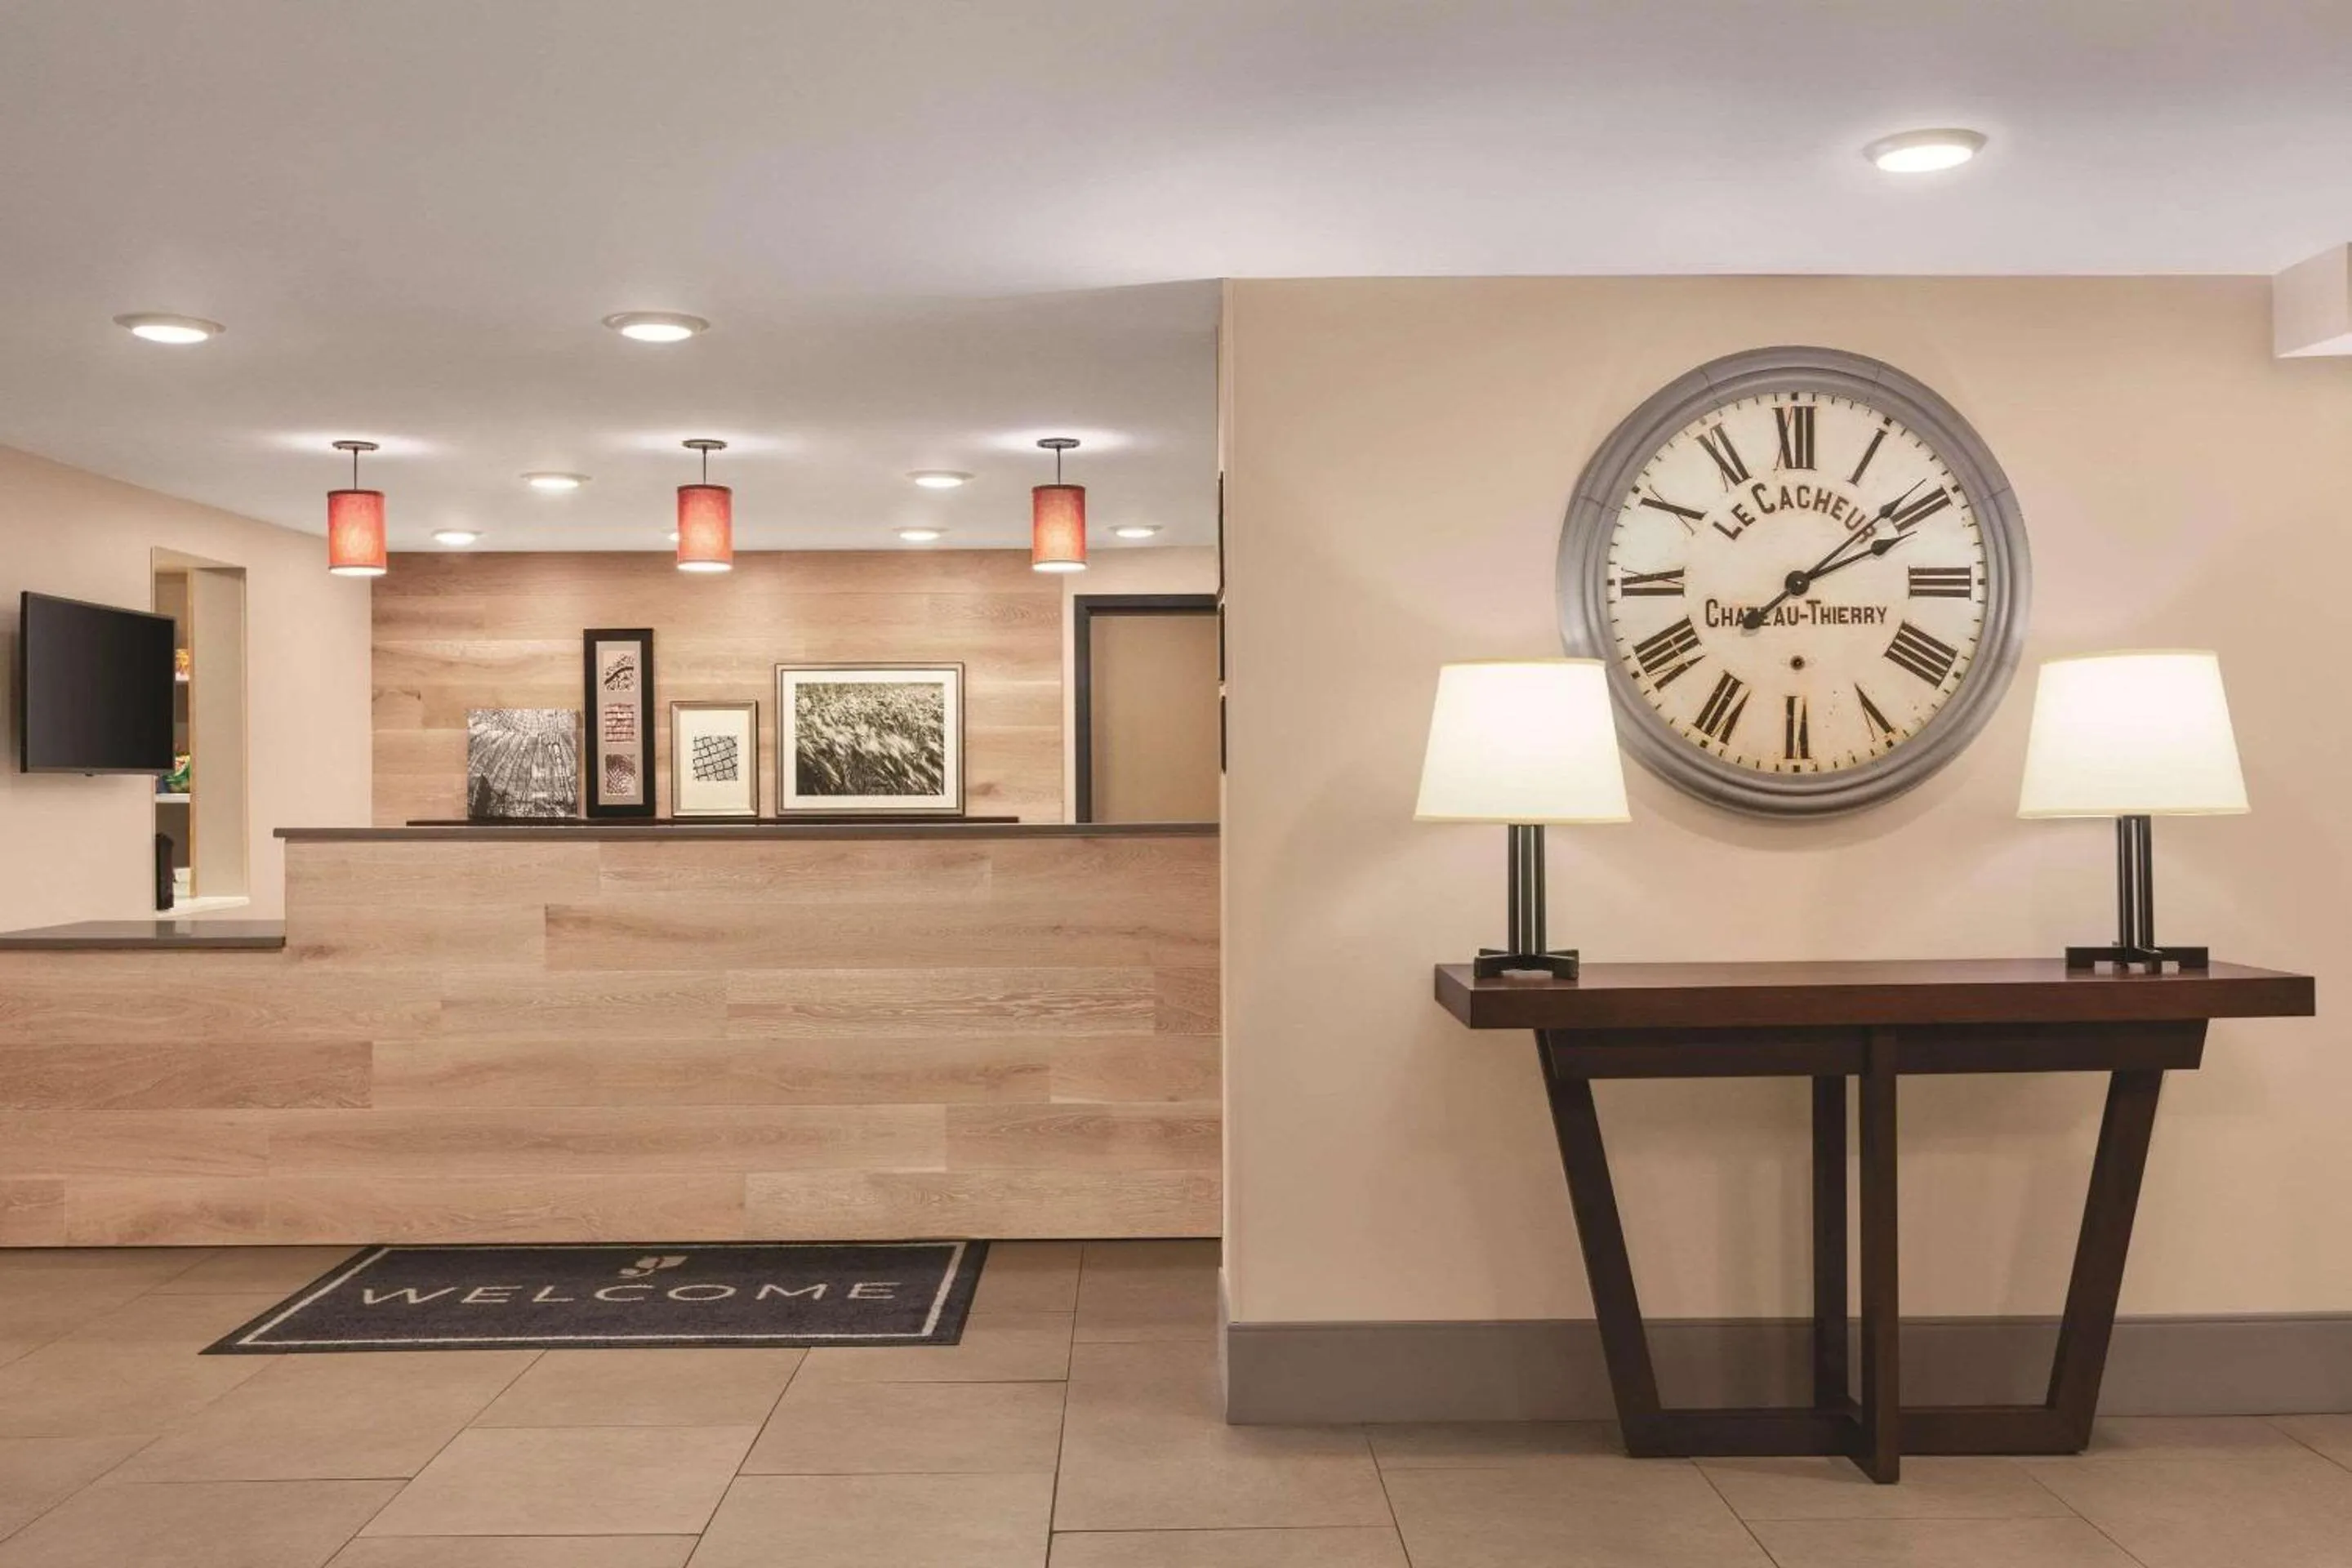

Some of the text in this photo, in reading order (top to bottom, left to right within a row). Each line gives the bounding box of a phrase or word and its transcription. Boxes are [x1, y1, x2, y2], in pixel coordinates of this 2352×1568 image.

[1695, 422, 1753, 492] XI
[1772, 405, 1818, 470] XII
[1846, 427, 1888, 487] I
[1639, 483, 1708, 536] X
[1713, 482, 1878, 545] LE CACHEUR
[1908, 565, 1971, 600] III
[363, 1281, 902, 1305] WELCOME
